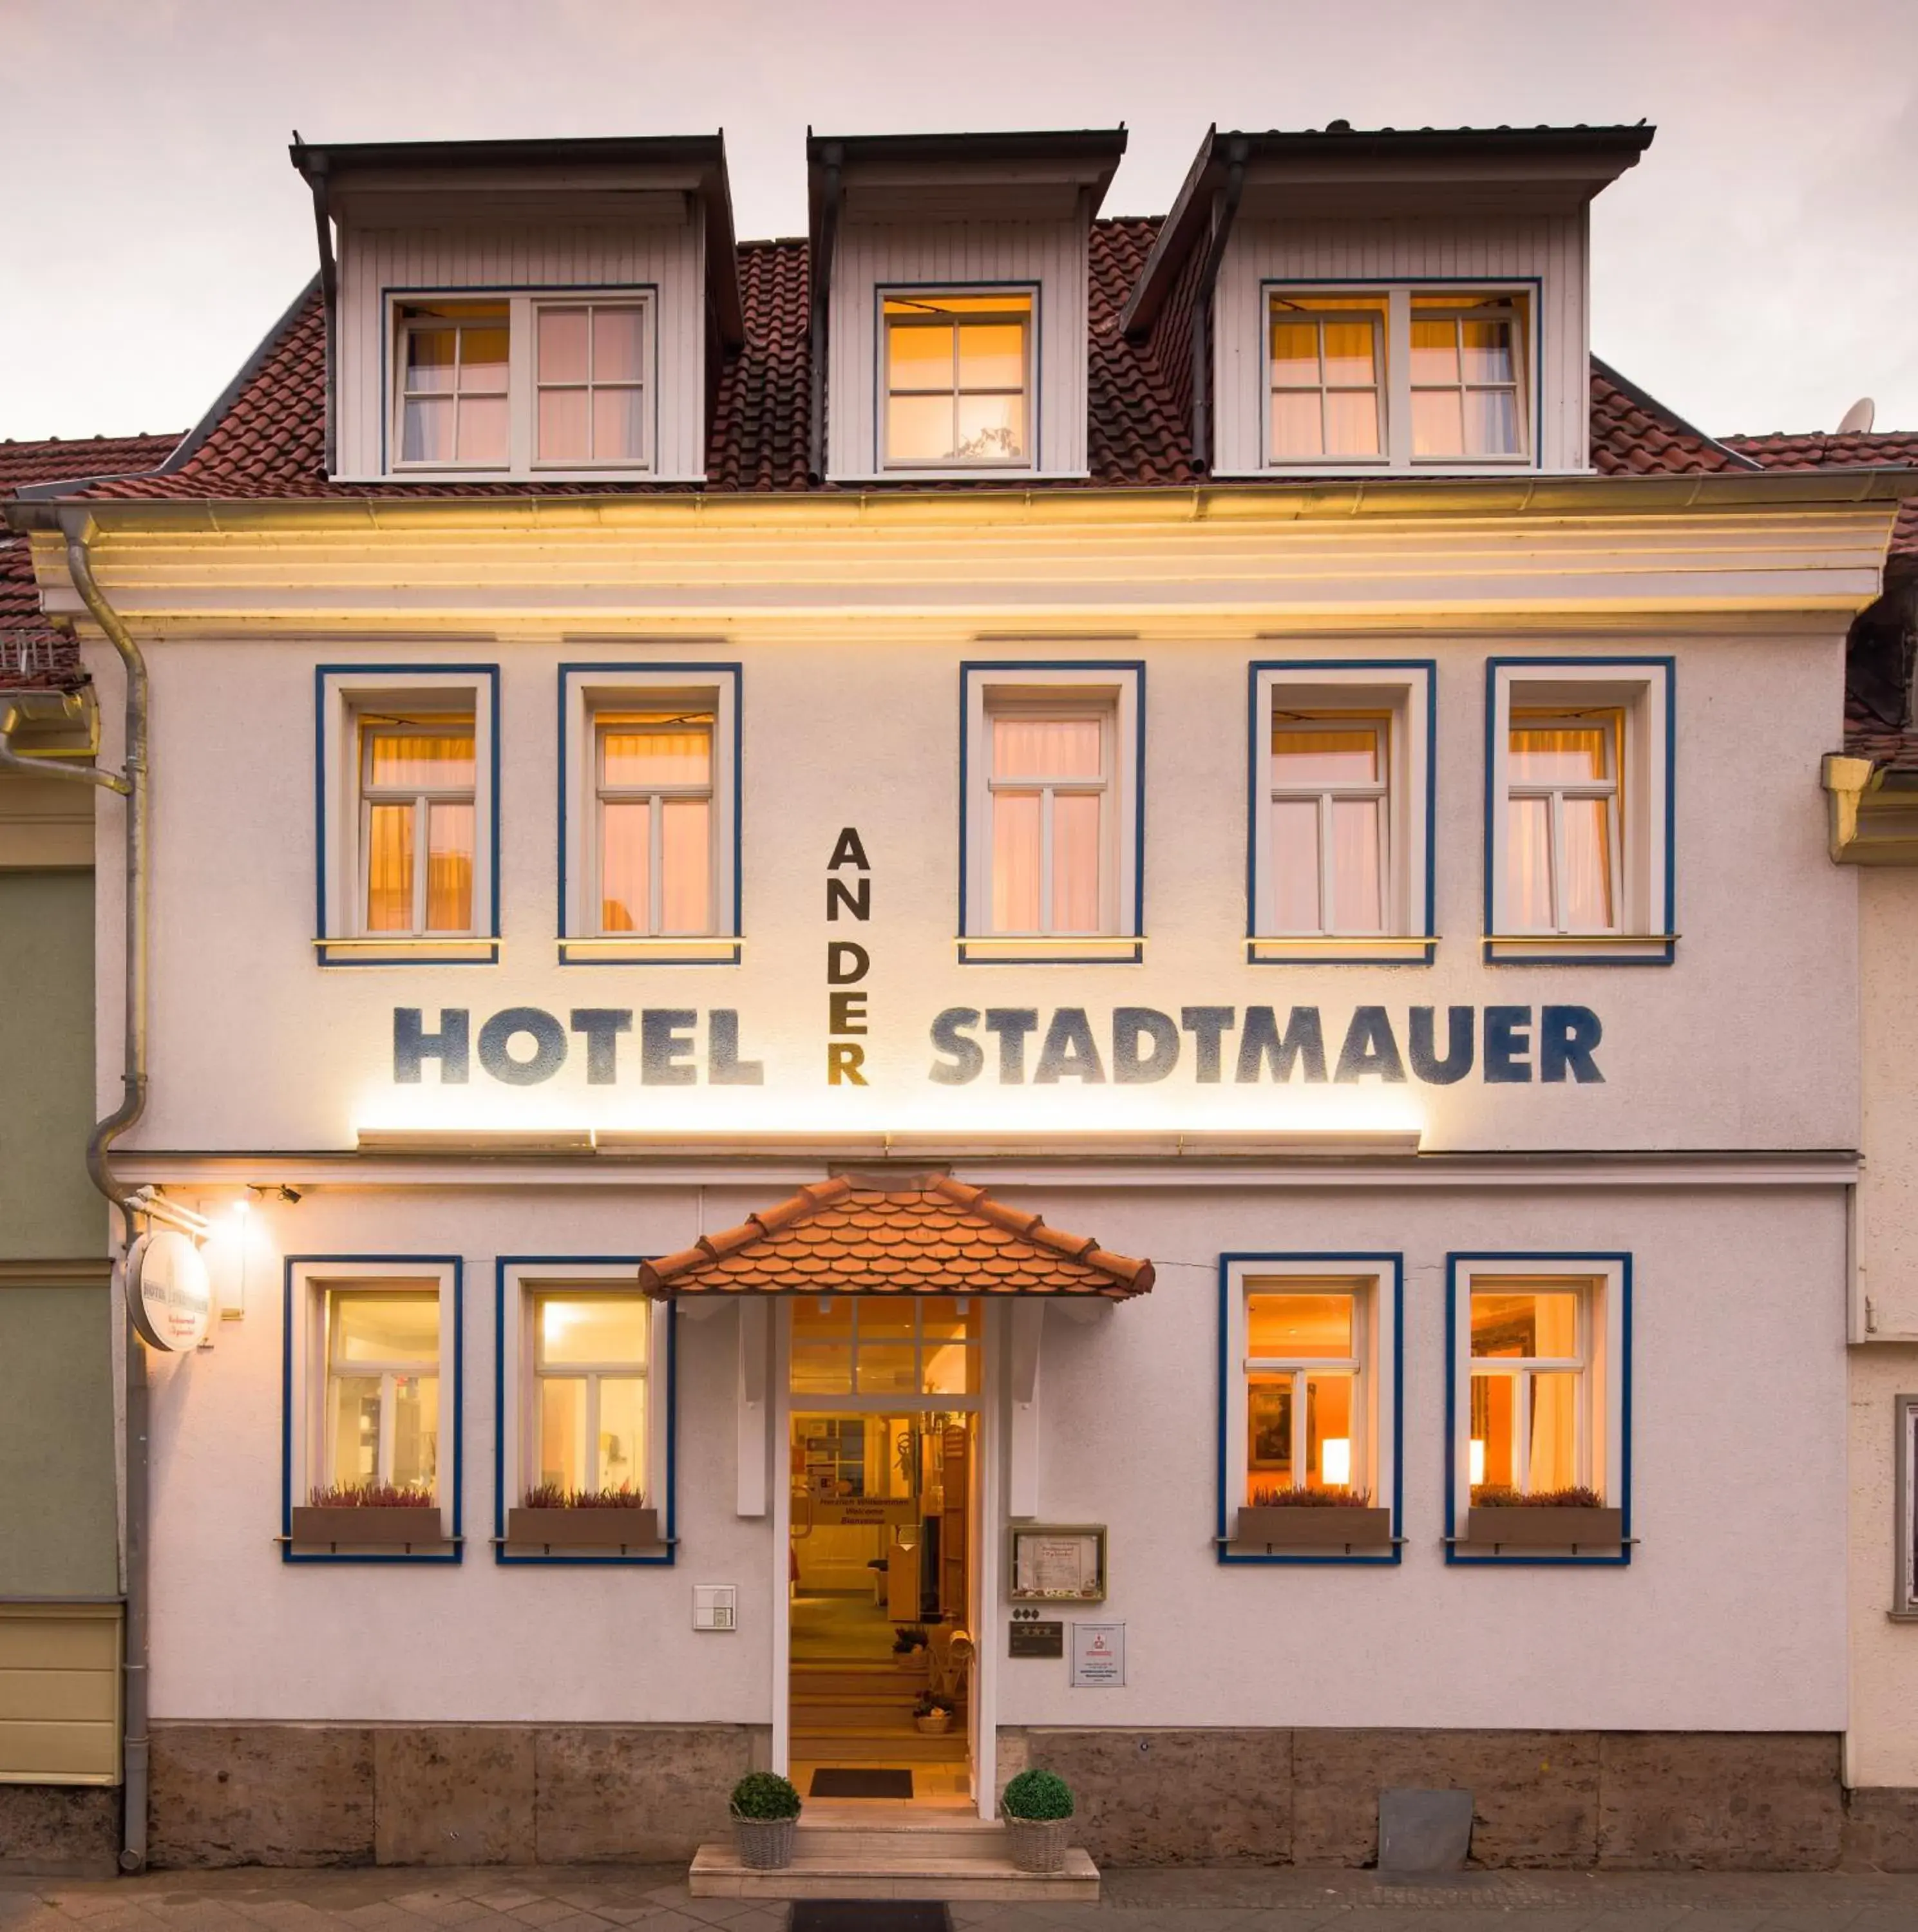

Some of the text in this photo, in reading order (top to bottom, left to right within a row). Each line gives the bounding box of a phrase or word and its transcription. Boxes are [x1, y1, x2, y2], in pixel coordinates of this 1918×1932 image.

[827, 828, 871, 1086] AN DER
[394, 1005, 1606, 1086] HOTEL STADTMAUER
